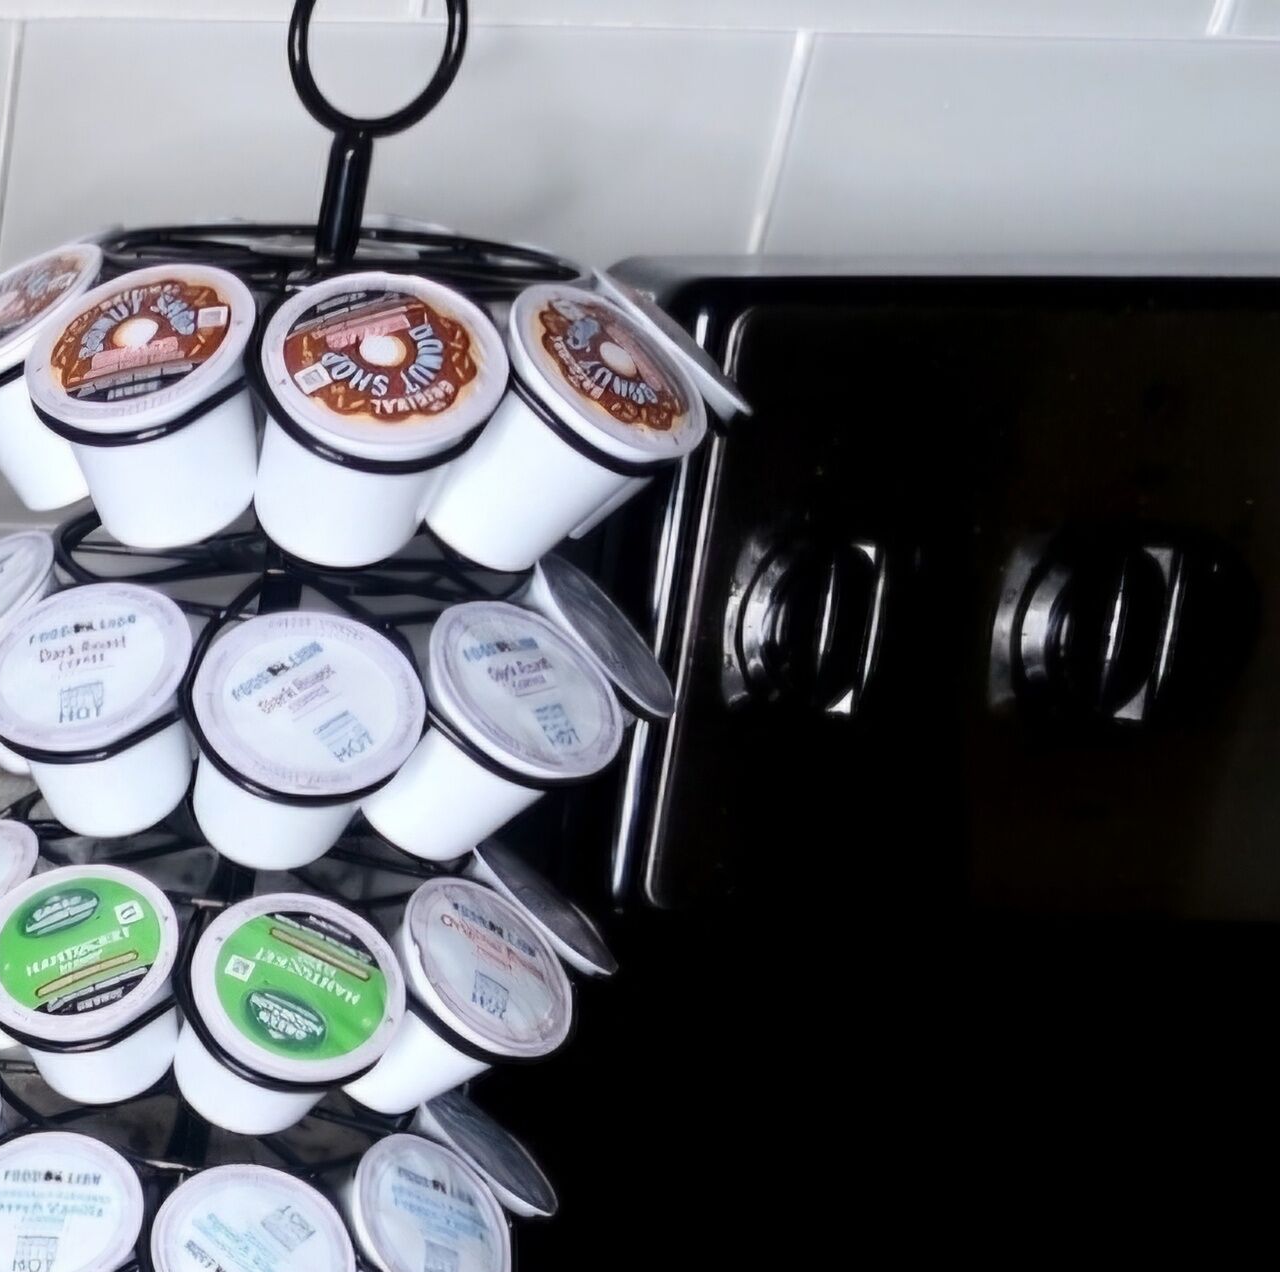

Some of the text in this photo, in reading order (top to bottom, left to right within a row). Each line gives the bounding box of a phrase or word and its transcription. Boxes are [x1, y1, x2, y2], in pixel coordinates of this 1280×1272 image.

[320, 351, 390, 397] SHOP
[399, 323, 444, 396] DONUT
[58, 702, 105, 724] HOT
